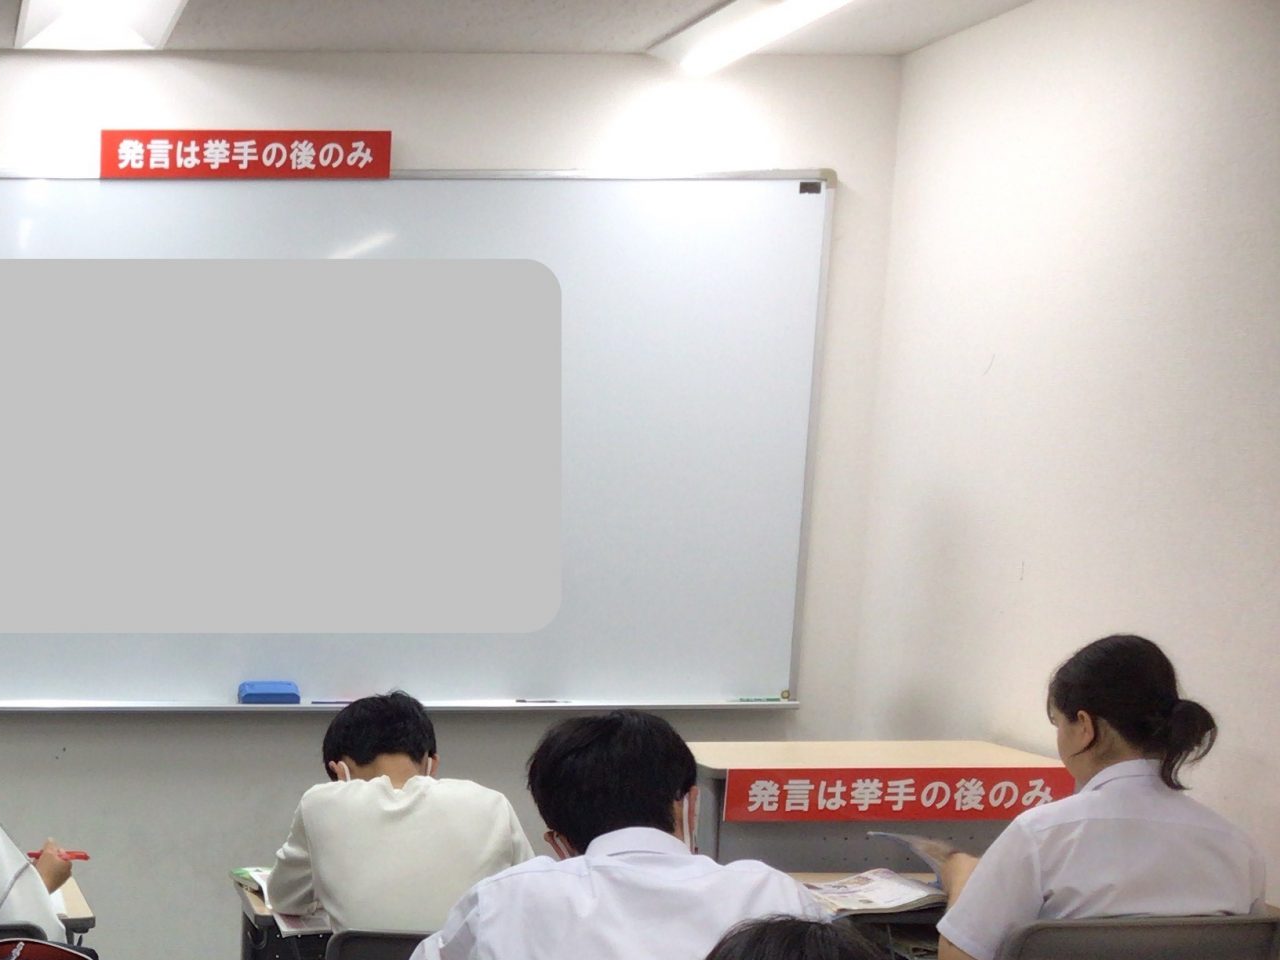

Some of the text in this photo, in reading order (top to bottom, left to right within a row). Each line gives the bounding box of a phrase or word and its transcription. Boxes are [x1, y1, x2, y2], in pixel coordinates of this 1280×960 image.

[117, 138, 373, 170] 発言は挙手の後のみ
[747, 778, 1054, 812] 発言は挙手の後のみ
